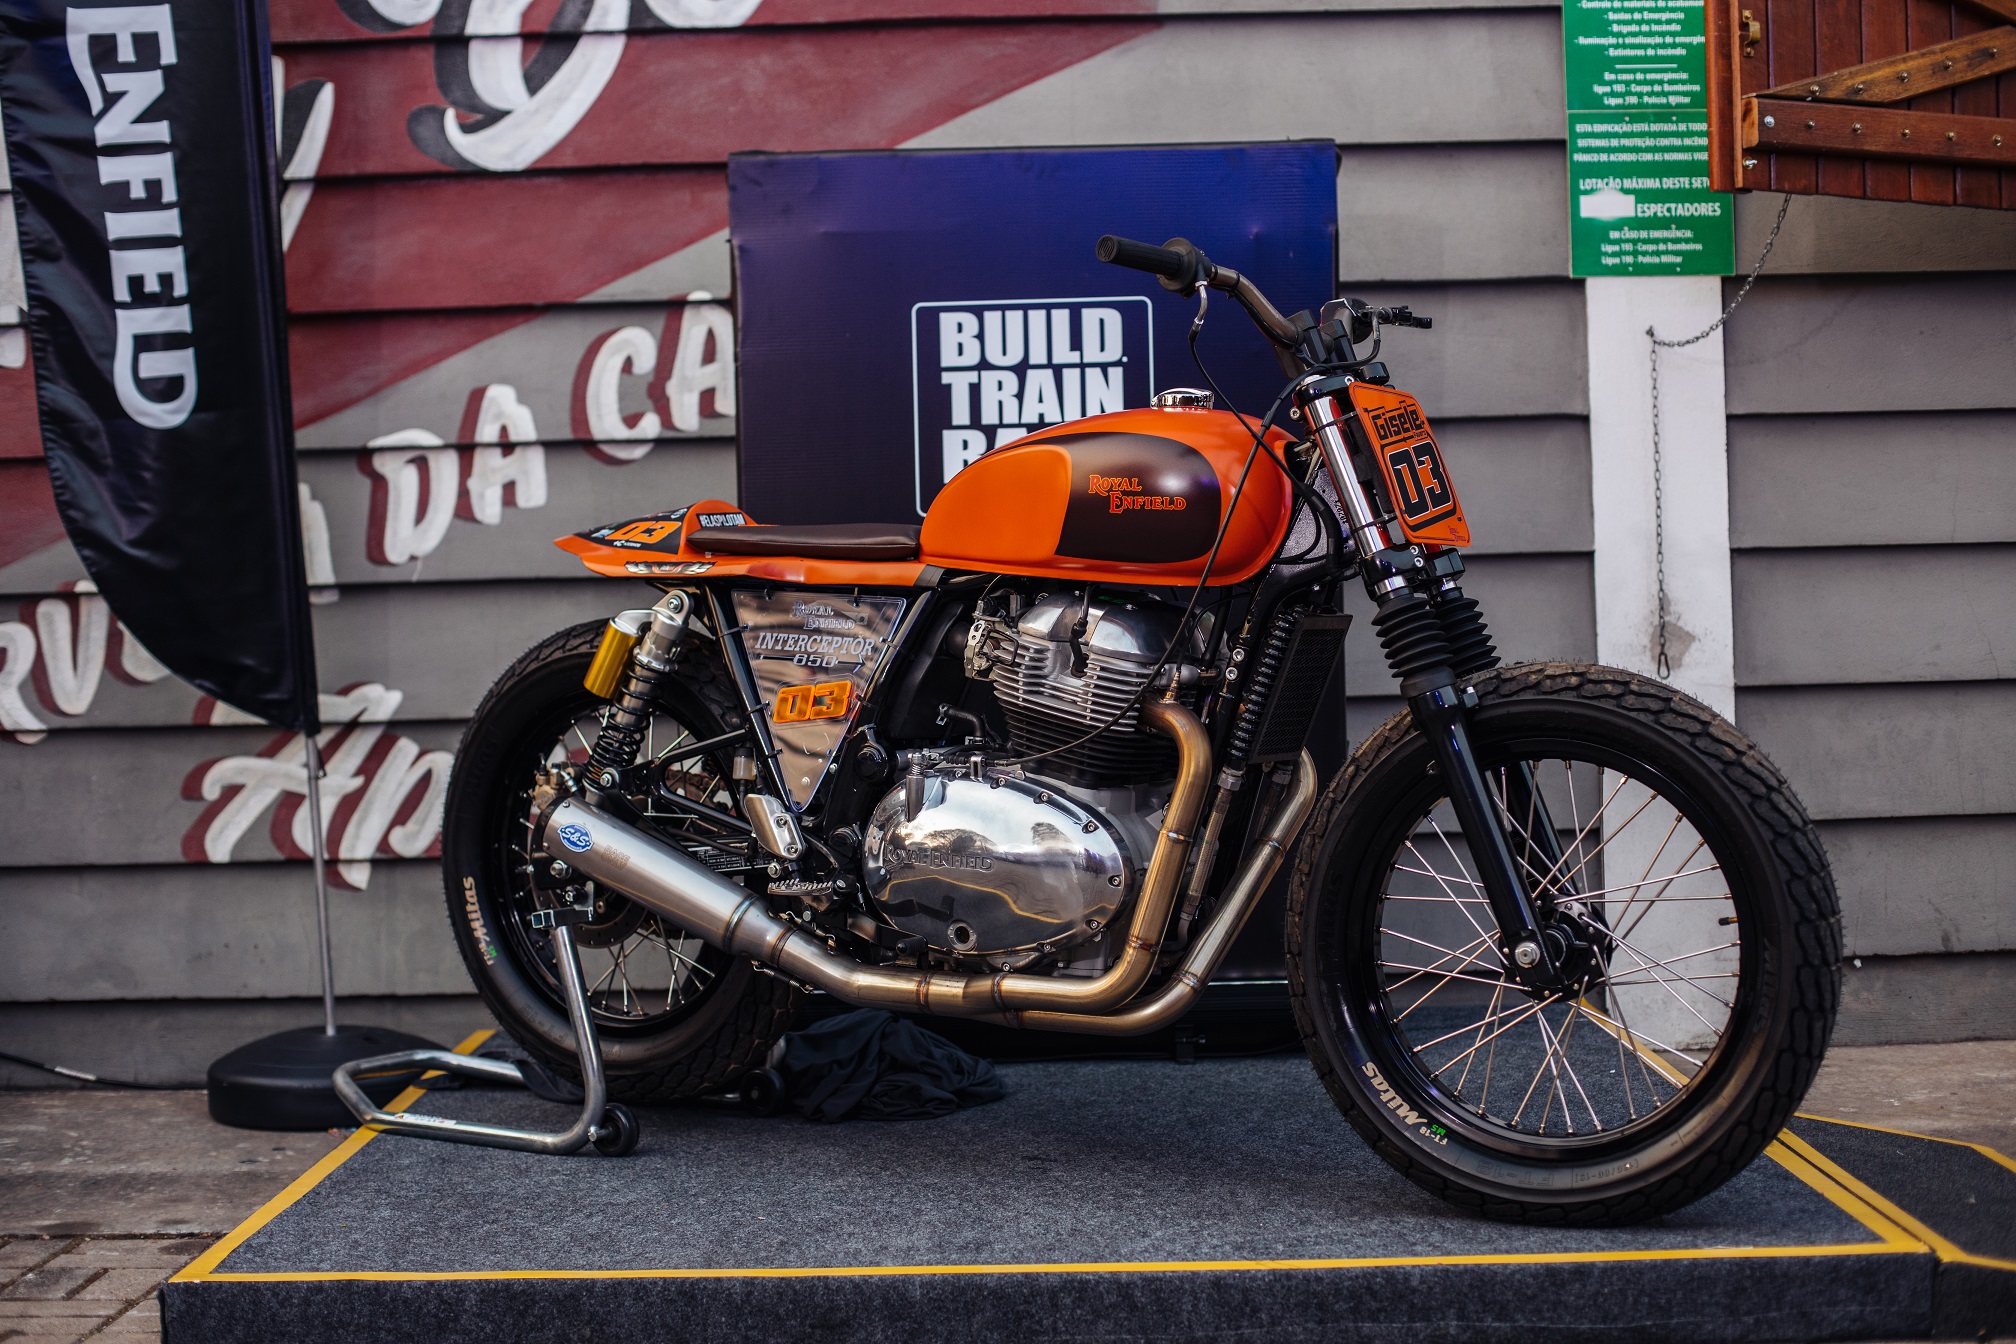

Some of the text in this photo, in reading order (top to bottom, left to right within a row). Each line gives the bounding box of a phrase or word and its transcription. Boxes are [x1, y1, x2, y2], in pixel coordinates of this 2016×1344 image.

[1633, 12, 1642, 20] de
[1612, 23, 1639, 34] Brigada
[1640, 24, 1650, 32] de
[1664, 35, 1674, 43] de
[1609, 47, 1645, 57] Extintores
[1646, 47, 1655, 56] de
[1604, 72, 1616, 81] Em
[1635, 72, 1644, 80] de
[1630, 84, 1652, 94] Corpo
[1653, 83, 1662, 92] de
[1663, 83, 1700, 92] Bombeiros
[1575, 124, 1592, 133] ESTA
[1593, 122, 1632, 133] EDIFICAÇÃO
[1650, 123, 1677, 132] DOTADA
[1678, 123, 1687, 131] DE
[1577, 138, 1610, 147] SISTEMAS
[1611, 138, 1619, 147] DE
[1620, 136, 1655, 148] PROTEÇÃO
[1656, 137, 1682, 146] CONTRA
[1600, 153, 1608, 162] DE
[1609, 152, 1637, 162] ACORDO
[1638, 152, 1653, 161] COM
[1654, 152, 1663, 161] AS
[1664, 152, 1692, 161] NORMAS
[1579, 176, 1621, 190] LOTAÇÃO
[1623, 176, 1661, 189] MÁXIMA
[1662, 177, 1690, 189] DESTE
[66, 4, 197, 430] ENFIELD
[1637, 203, 1721, 217] ESPECTADORES
[1609, 230, 1620, 239] EM
[1621, 230, 1638, 239] CASO
[1640, 230, 1648, 239] DE
[1601, 243, 1620, 254] Ligue
[1638, 243, 1658, 253] Corpo
[1658, 242, 1667, 251] de
[1667, 242, 1702, 252] Bombeiros
[1601, 255, 1620, 266] Ligue
[1661, 255, 1683, 264] Militar
[941, 366, 1124, 426] TRAIN
[1088, 474, 1142, 496] ROYAL
[1387, 440, 1452, 520] 03
[1109, 491, 1187, 514] ENFIELD
[604, 521, 682, 544] 03
[754, 632, 877, 656] INTERCEPTOR
[793, 653, 838, 668] 650
[773, 680, 853, 723] 03
[562, 828, 589, 846] S&S
[1362, 1061, 1427, 1125] Mitas
